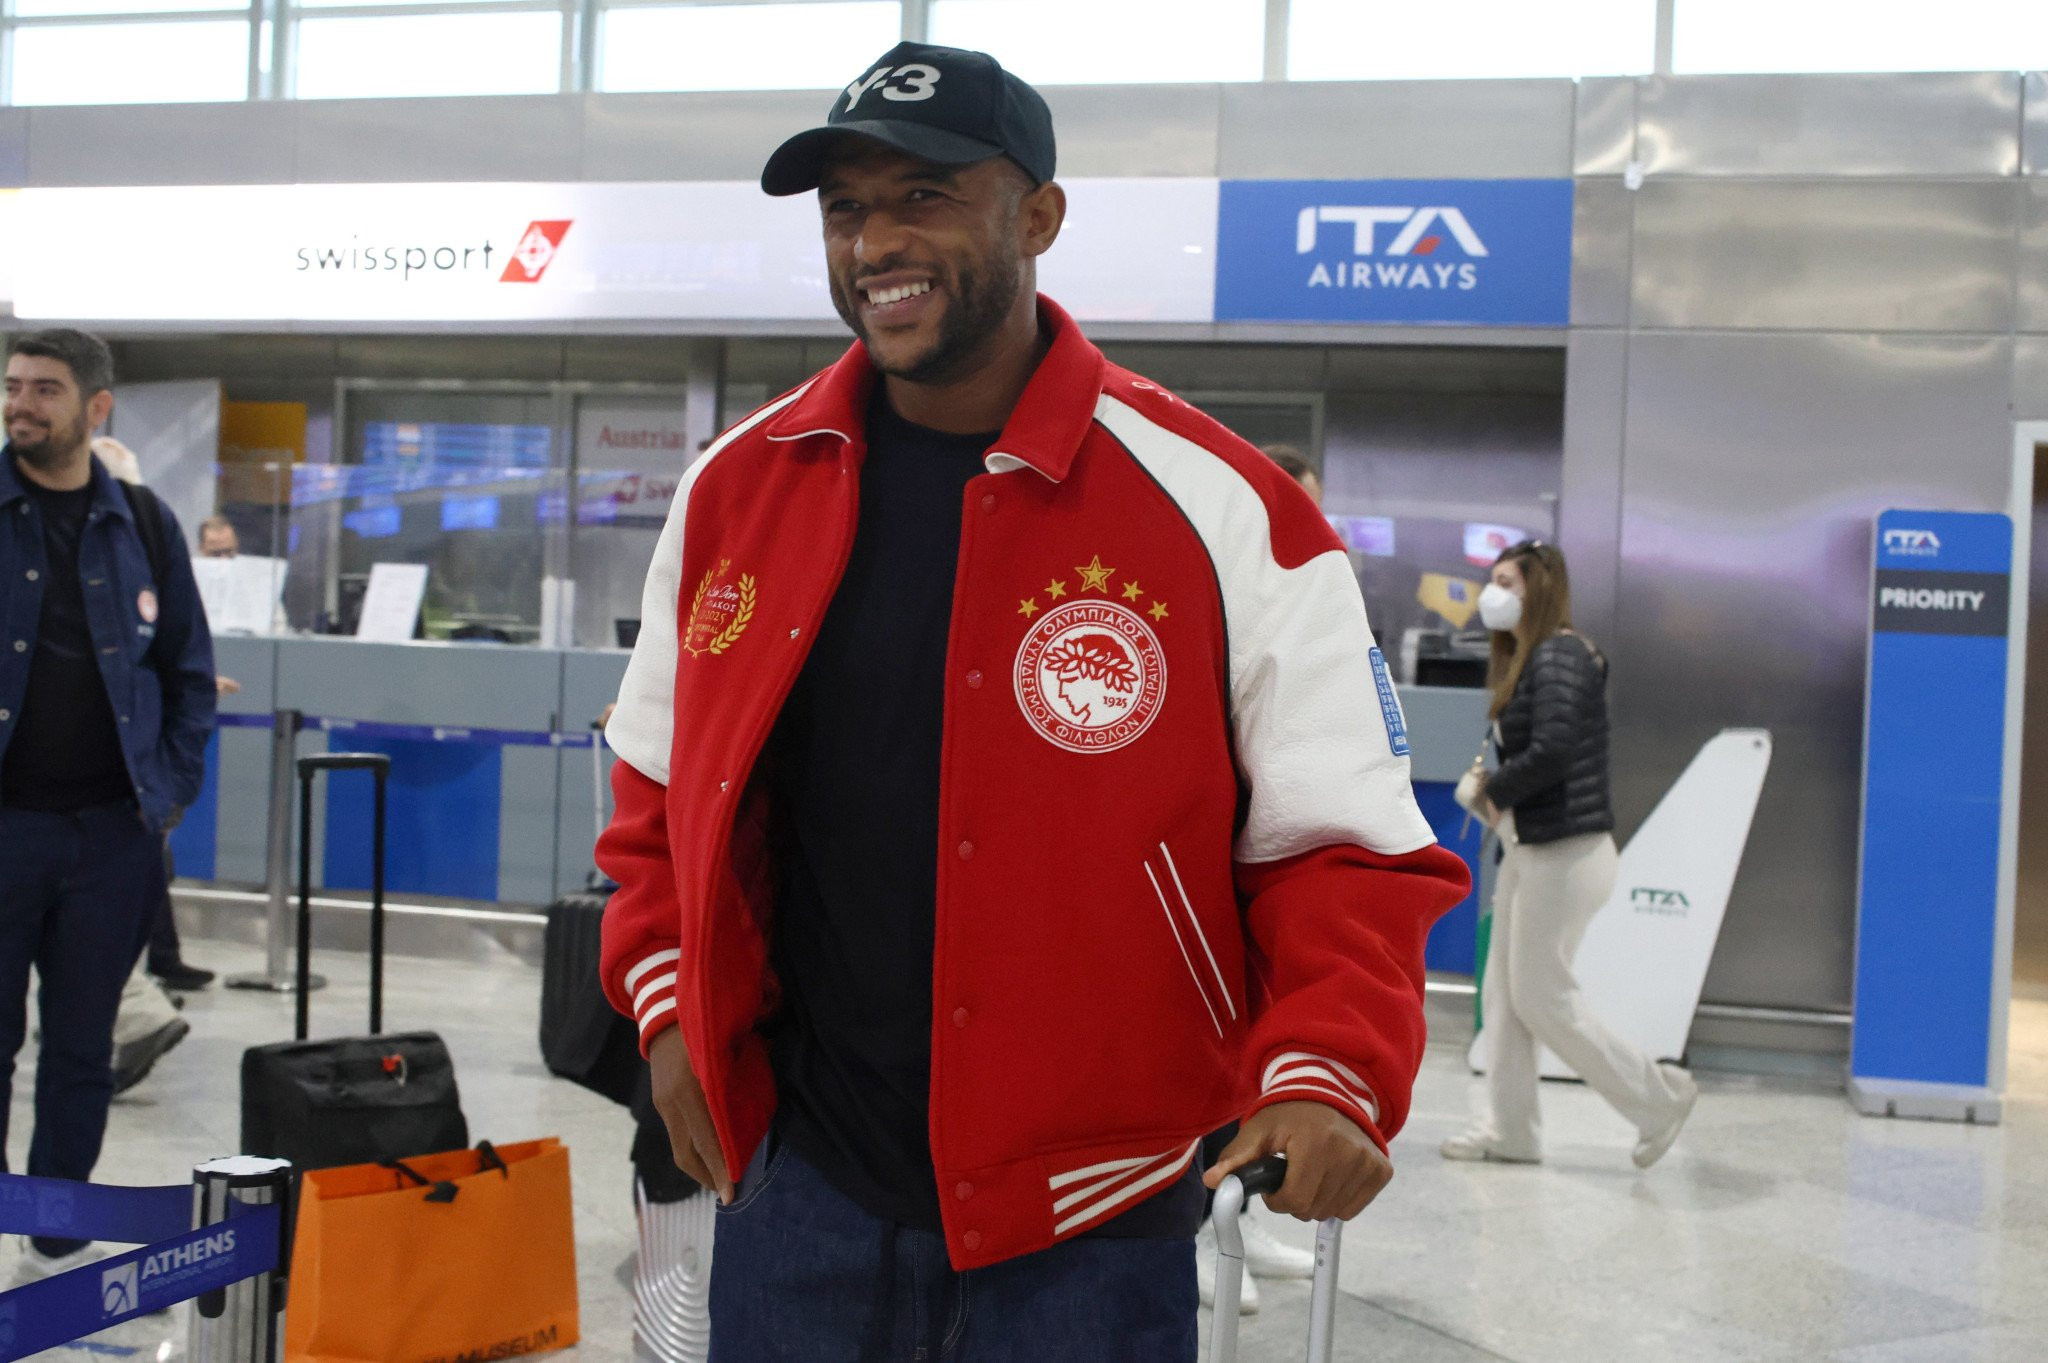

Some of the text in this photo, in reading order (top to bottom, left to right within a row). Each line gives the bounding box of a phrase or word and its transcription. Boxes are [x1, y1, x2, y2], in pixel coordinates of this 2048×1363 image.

[1296, 205, 1490, 257] ITA
[297, 234, 493, 281] swissport
[1307, 261, 1477, 290] AIRWAYS
[1884, 529, 1941, 549] ITA
[1881, 587, 1985, 611] PRIORITY
[1043, 608, 1143, 641] ΟΛΥΜΠΙΑΚΟΣ
[1103, 696, 1127, 708] 1925
[141, 1230, 235, 1280] ATHENS
